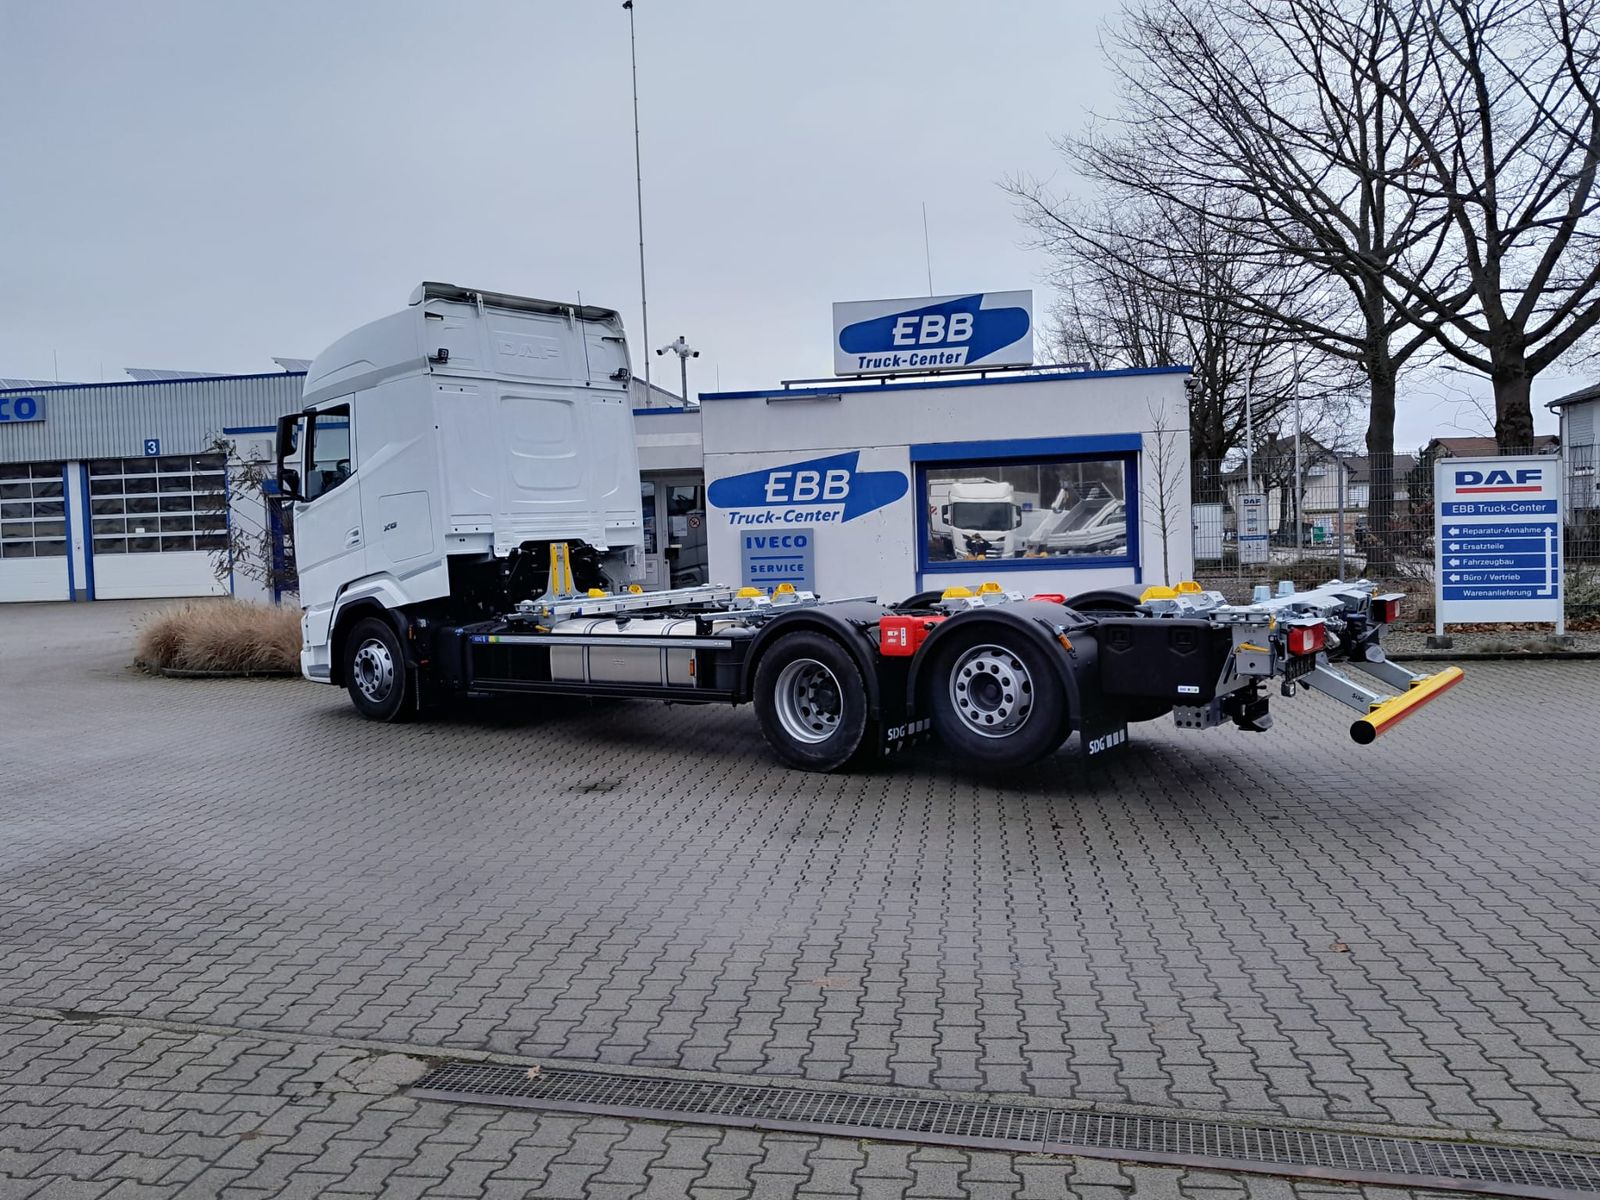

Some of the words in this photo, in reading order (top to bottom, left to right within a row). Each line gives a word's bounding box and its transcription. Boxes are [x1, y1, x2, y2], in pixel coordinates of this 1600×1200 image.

[893, 313, 974, 346] EBB
[859, 353, 962, 369] Truck-Center
[147, 441, 156, 454] 3
[1455, 469, 1542, 485] DAF
[765, 469, 850, 502] EBB
[1452, 504, 1475, 513] EBB
[1478, 503, 1546, 513] Truck-Center
[729, 509, 840, 525] Truck-Center
[1463, 527, 1541, 535] Reparatur-Annahme
[746, 535, 808, 549] IVECO
[750, 563, 804, 573] SERVICE
[1462, 558, 1515, 567] Fahrzeugbau
[1463, 589, 1532, 599] Warenanlieferung
[887, 725, 905, 741] SDG
[1089, 736, 1105, 755] SDG
